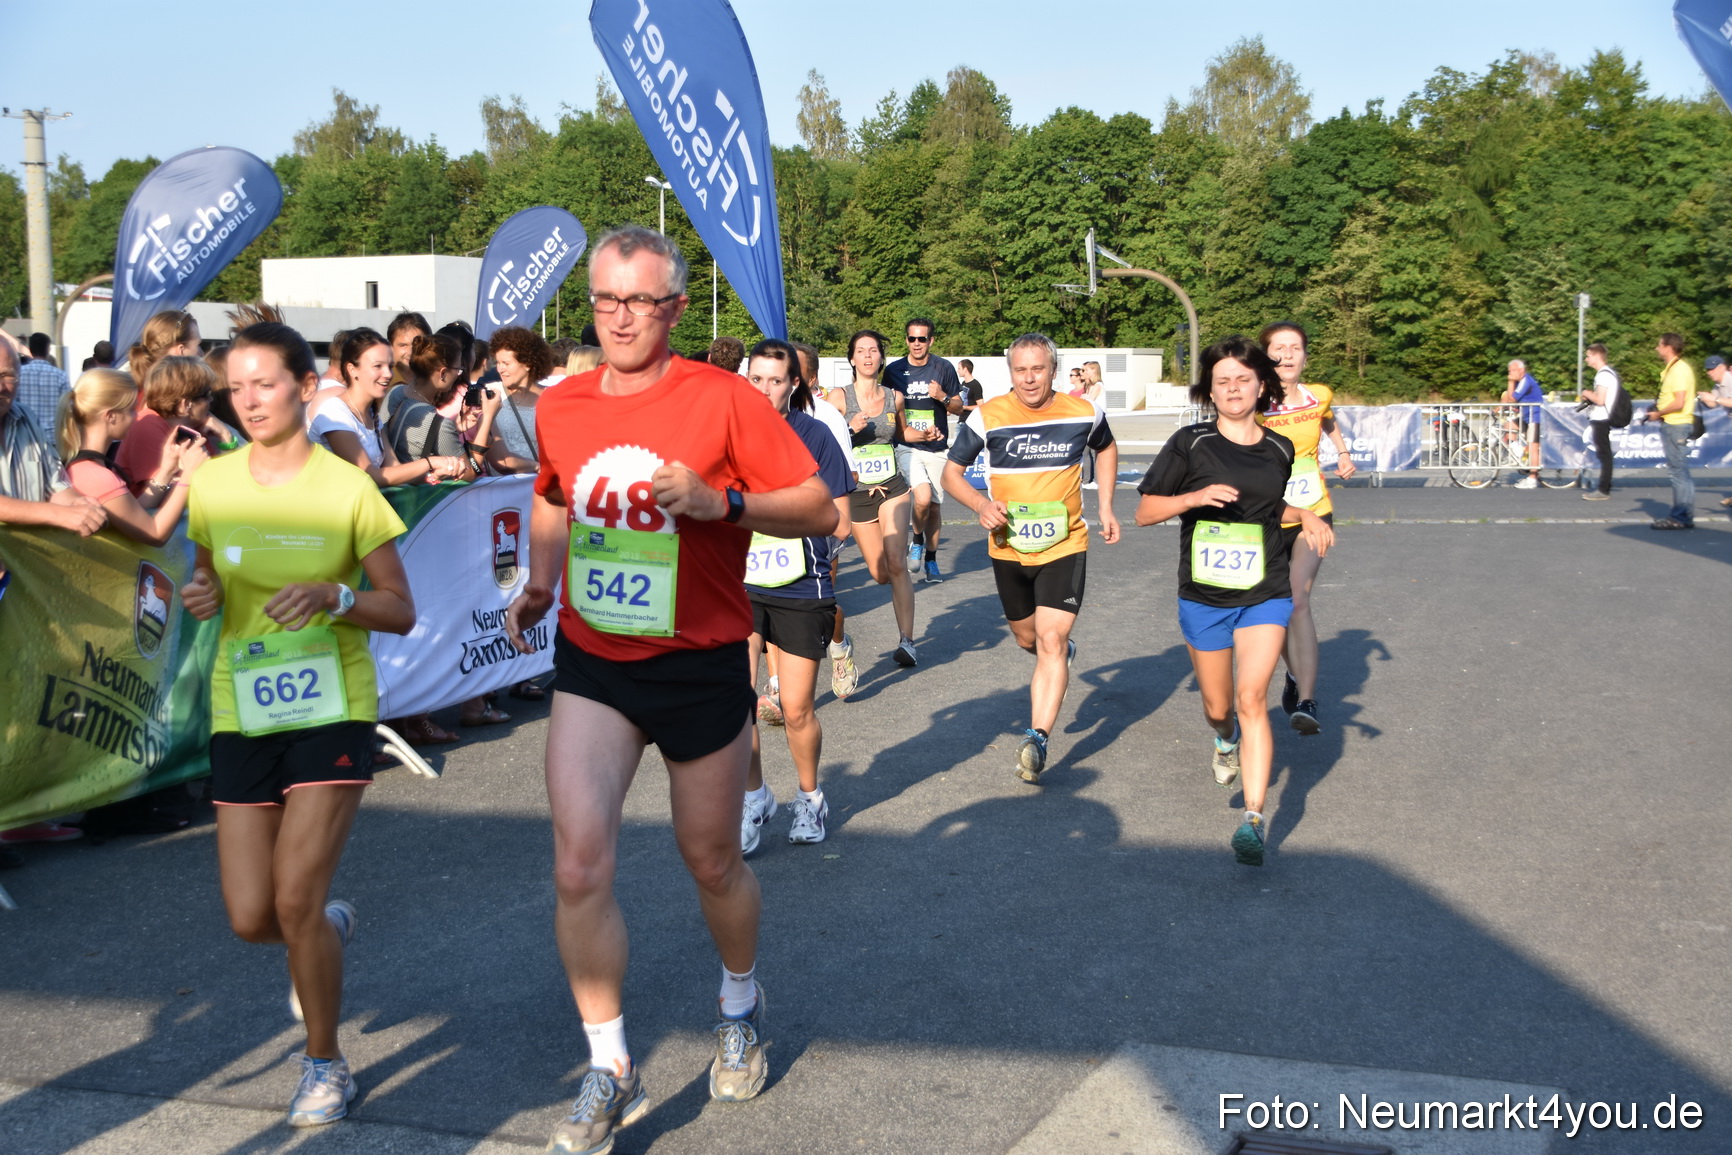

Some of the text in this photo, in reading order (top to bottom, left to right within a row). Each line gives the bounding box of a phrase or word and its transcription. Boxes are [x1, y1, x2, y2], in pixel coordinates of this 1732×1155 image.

[147, 177, 247, 284] Fischer
[175, 201, 257, 284] AUTOMOBILE
[502, 226, 563, 311] Fischer
[522, 242, 570, 310] AUTOMOBILE
[1263, 418, 1290, 428] MAX
[1016, 441, 1073, 454] Fischer
[1022, 452, 1069, 460] AUTOMOBILE
[857, 459, 889, 473] 1291
[1286, 478, 1310, 496] 72
[585, 475, 667, 533] 48
[1018, 522, 1056, 539] 403
[746, 548, 790, 571] 376
[1199, 547, 1257, 570] 1237
[586, 568, 652, 607] 542
[579, 605, 658, 621] Bernhard Hammerbacher
[253, 668, 322, 707] 662
[268, 706, 314, 720] Regina Reindl
